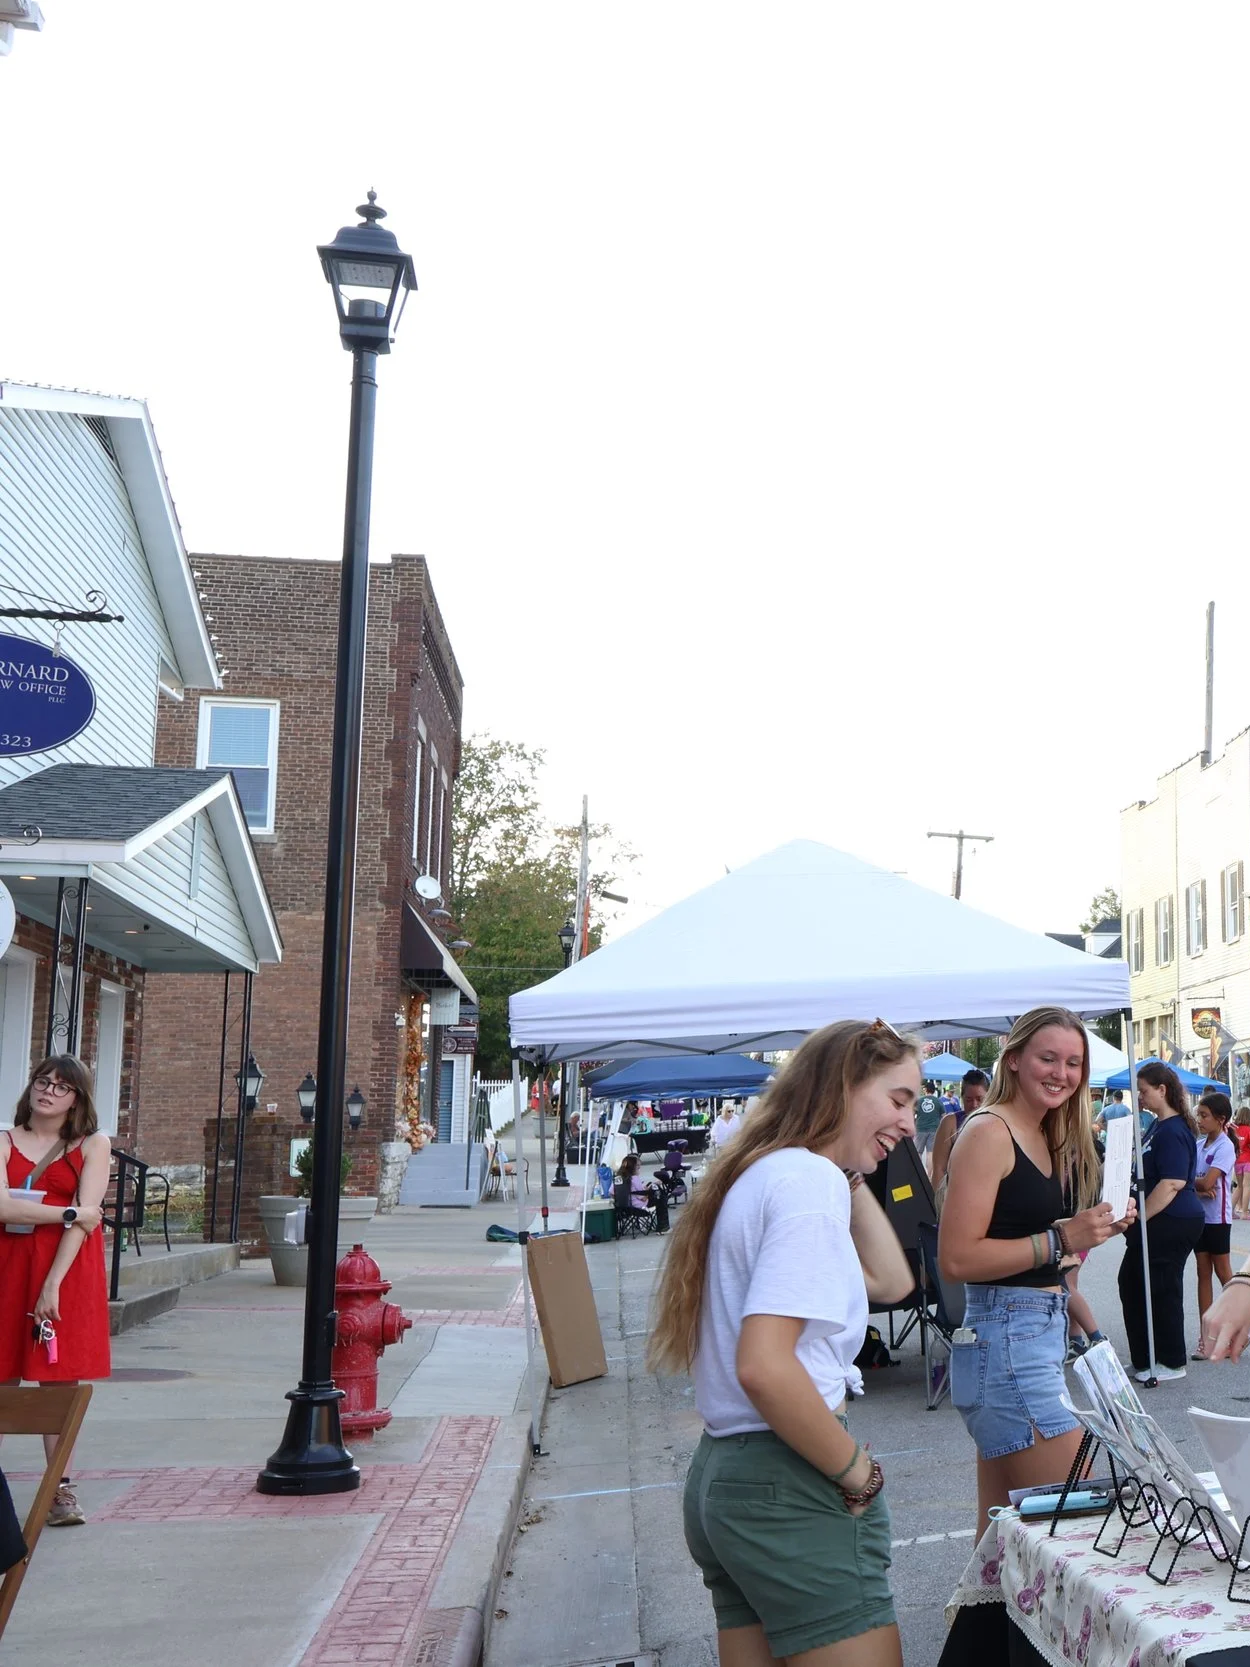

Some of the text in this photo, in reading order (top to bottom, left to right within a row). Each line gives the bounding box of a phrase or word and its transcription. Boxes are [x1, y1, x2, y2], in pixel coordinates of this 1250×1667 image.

[18, 681, 67, 696] OFFICE
[48, 696, 66, 704] PLLC
[0, 734, 32, 748] 323
